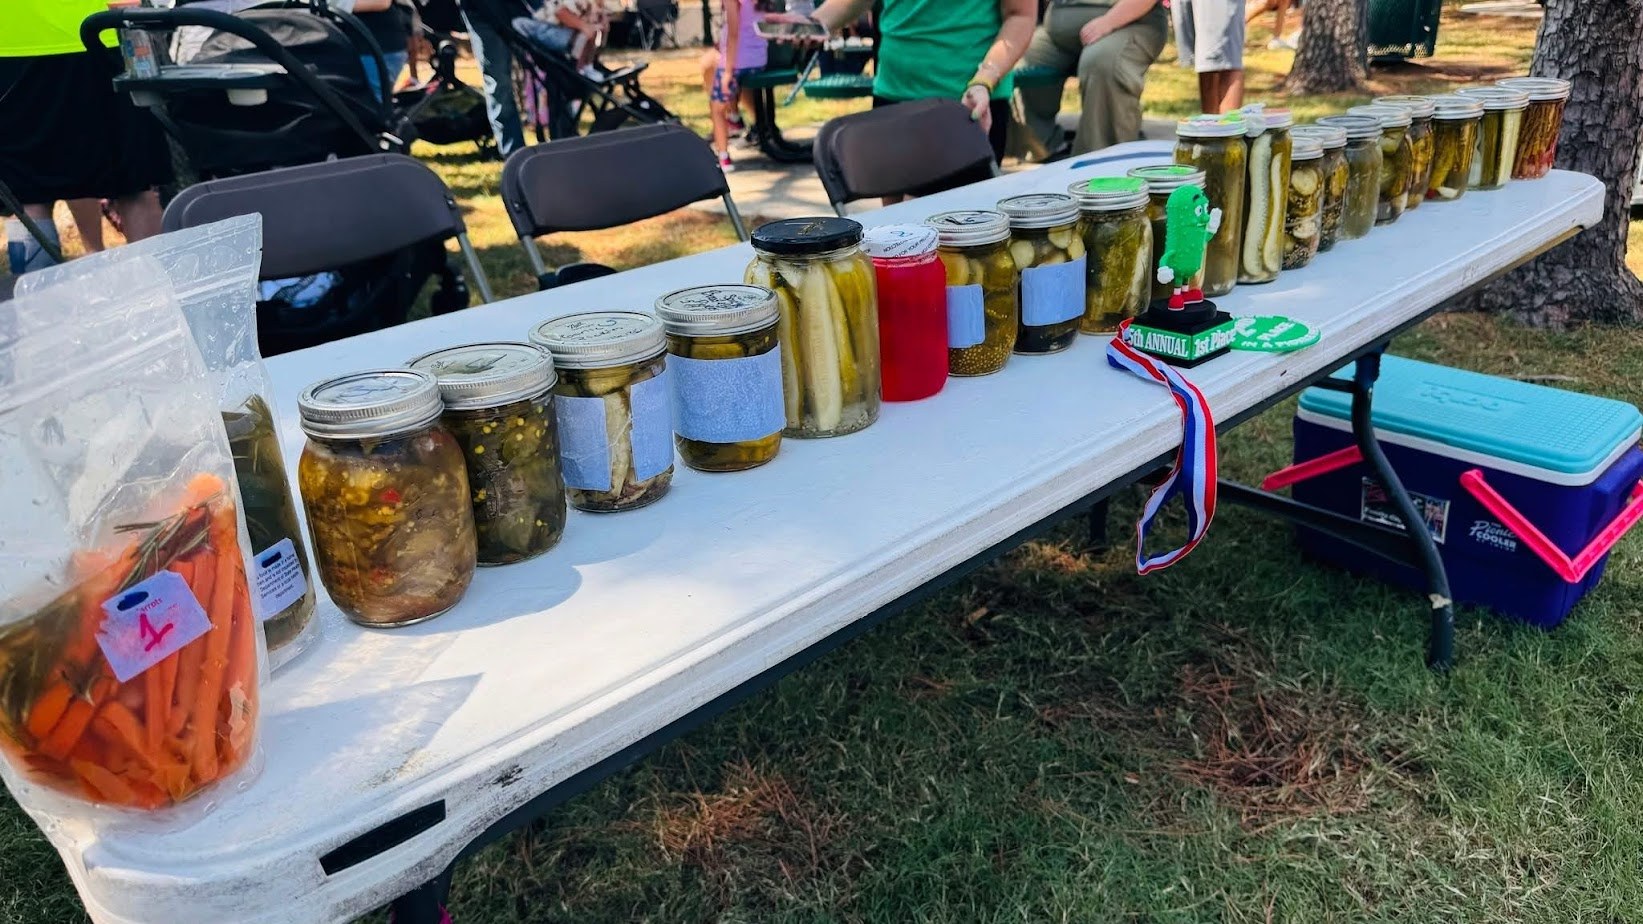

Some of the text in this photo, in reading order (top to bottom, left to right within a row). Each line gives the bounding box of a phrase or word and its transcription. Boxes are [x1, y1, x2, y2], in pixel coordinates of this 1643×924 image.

[1144, 332, 1189, 358] ANNUAL
[1194, 328, 1237, 358] 1st Place
[1469, 520, 1517, 538] Picnic
[1476, 531, 1517, 549] COOLER
